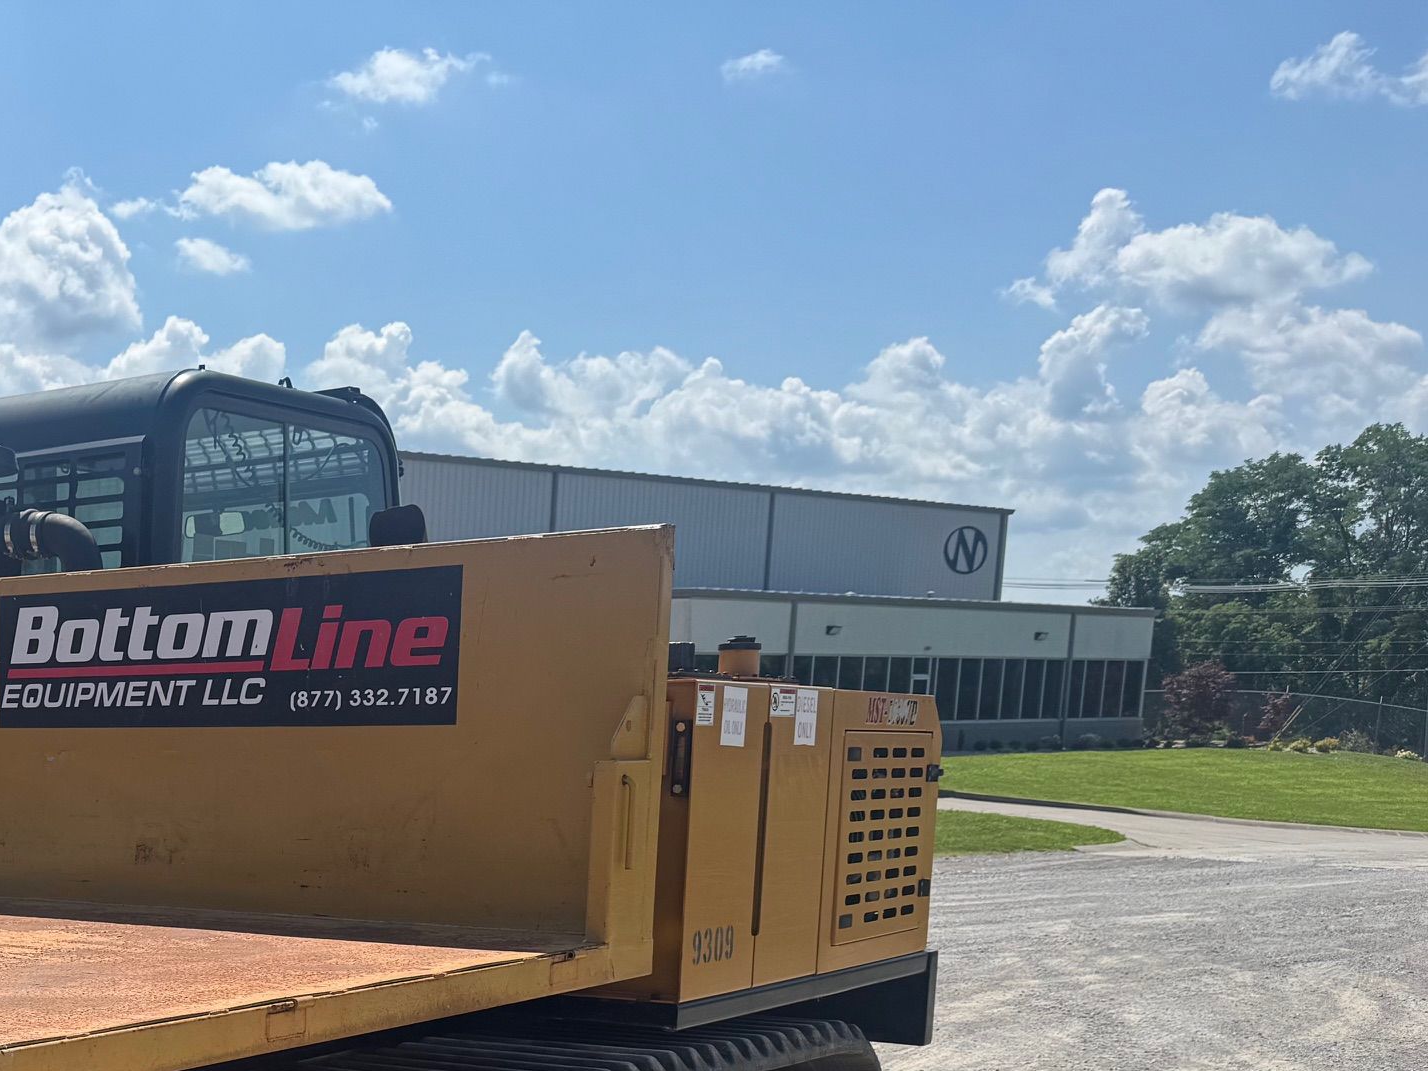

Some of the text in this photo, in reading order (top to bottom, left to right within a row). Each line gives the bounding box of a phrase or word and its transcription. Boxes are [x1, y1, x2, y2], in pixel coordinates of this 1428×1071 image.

[1, 677, 266, 709] EQUIPMENT LLC
[289, 686, 452, 712] (877) 332.7187
[797, 696, 816, 713] DIESEL
[797, 722, 813, 738] ONLY
[692, 925, 734, 965] 9309
